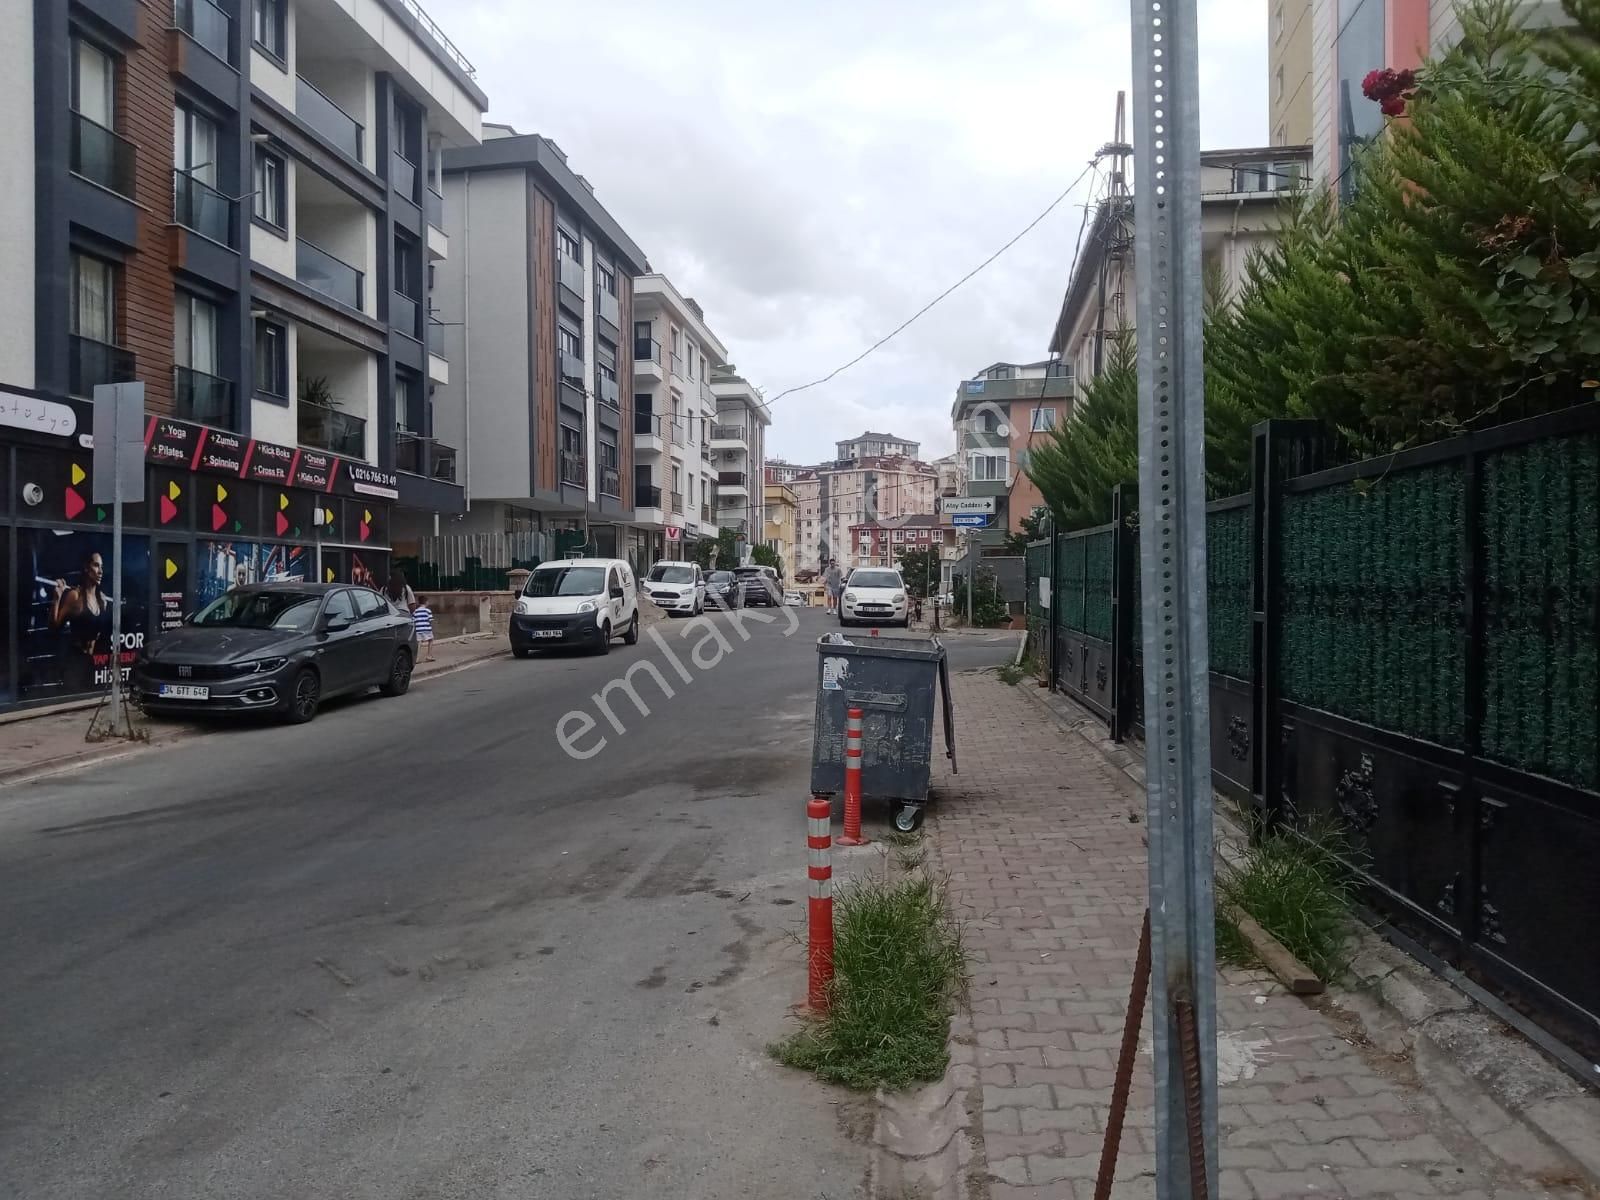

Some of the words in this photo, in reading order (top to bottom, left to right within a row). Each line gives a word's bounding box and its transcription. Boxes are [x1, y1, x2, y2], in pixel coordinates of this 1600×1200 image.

[168, 425, 186, 439] Yoga
[216, 434, 239, 448] Zumba
[158, 444, 184, 458] Pilates
[209, 456, 240, 471] Spinning
[257, 465, 275, 475] Cross
[355, 468, 370, 481] 0216
[390, 475, 397, 486] 49
[165, 685, 174, 694] 34
[176, 686, 190, 696] GTT
